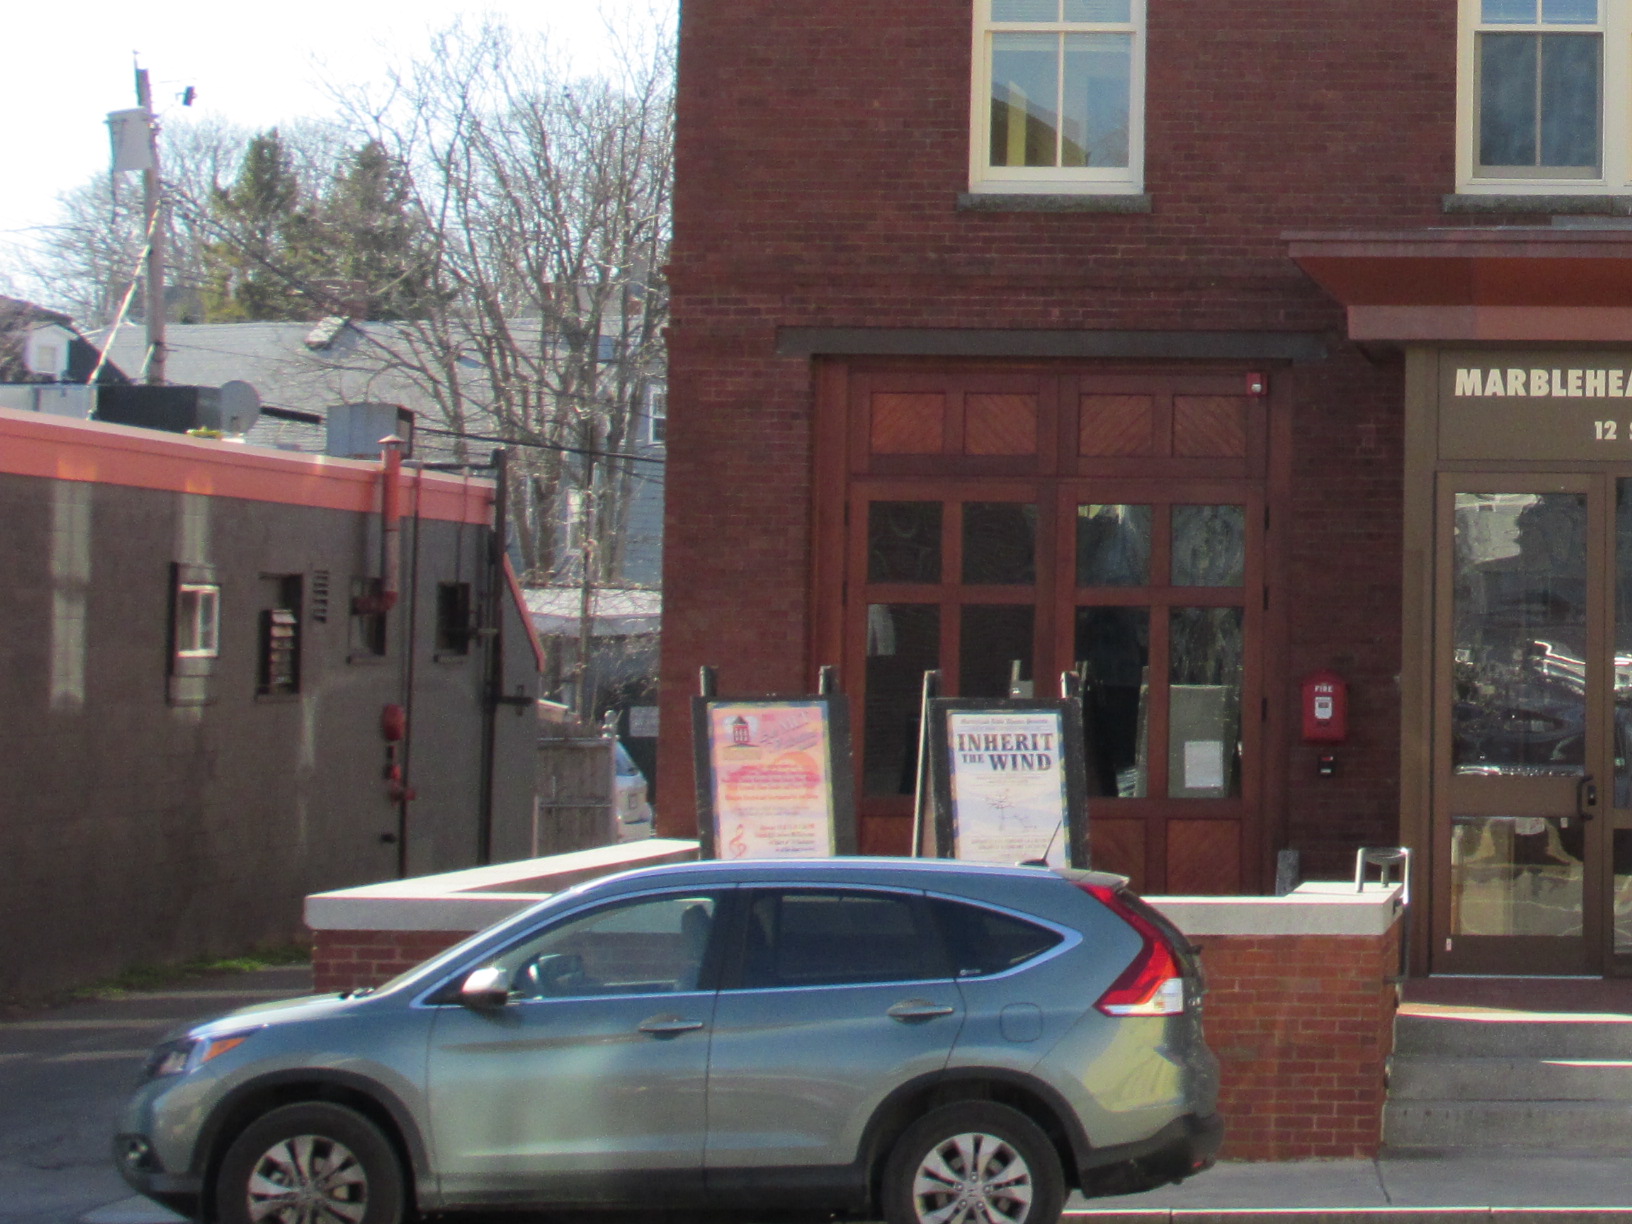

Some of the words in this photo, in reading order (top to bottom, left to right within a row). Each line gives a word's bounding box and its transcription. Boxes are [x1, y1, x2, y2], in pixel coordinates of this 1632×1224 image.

[1594, 420, 1617, 440] 12
[957, 733, 1053, 751] INHERIT
[962, 754, 984, 763] THE
[988, 753, 1051, 771] WIND
